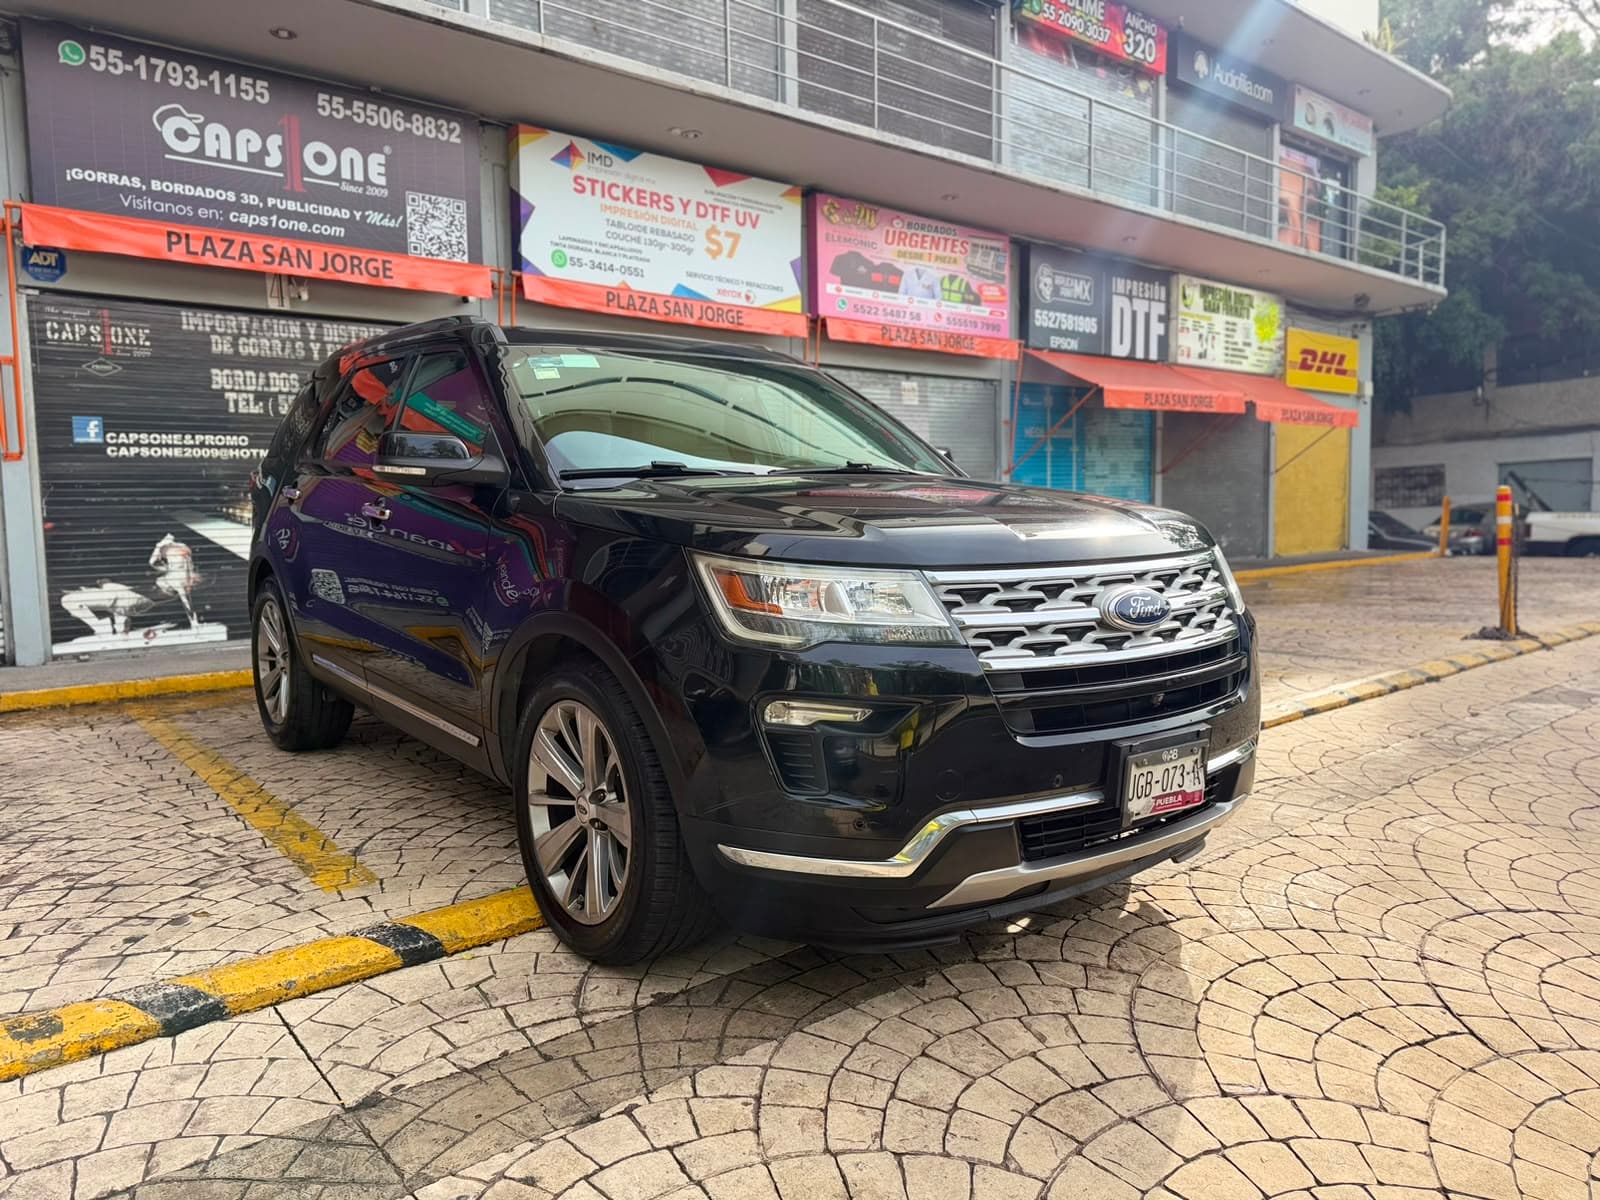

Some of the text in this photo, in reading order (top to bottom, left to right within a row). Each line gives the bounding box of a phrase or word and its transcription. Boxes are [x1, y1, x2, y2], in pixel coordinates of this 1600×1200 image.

[1042, 3, 1111, 43] 55 2090 3037
[1125, 12, 1158, 37] ANCHO
[1123, 28, 1157, 64] 320
[89, 45, 270, 104] 55-1793-1155
[317, 92, 461, 144] 55-5506-8832
[587, 151, 614, 168] IMD
[66, 168, 403, 228] ¡GORRAS, BORDADOS 3D, PUBLICIDAD Y Más!
[340, 181, 389, 198] Since 2009
[572, 174, 673, 211] STICKERS
[677, 196, 692, 216] Y
[695, 201, 731, 223] DTF
[735, 209, 761, 230] UV
[198, 206, 224, 221] en:
[229, 211, 345, 238] caps1one.com
[605, 218, 648, 235] TABLOIDE
[660, 216, 699, 232] DIGITAL
[906, 220, 958, 237] BORDADOS
[166, 230, 394, 279] PLAZA SAN JORGE
[704, 224, 742, 261] $7
[884, 229, 970, 256] URGENTES
[29, 253, 58, 267] ADT
[569, 256, 645, 278] 55-3414-0551
[716, 288, 742, 299] xerox
[605, 290, 744, 326] PLAZA SAN JORGE
[306, 322, 317, 341] Y
[1034, 308, 1098, 334] 5527581905
[1111, 294, 1167, 361] DTF
[210, 334, 234, 354] DE
[238, 337, 306, 360] GORRAS
[309, 342, 321, 361] Y
[880, 325, 976, 350] PLAZA SAN JORGE
[1049, 336, 1079, 351] EPSON
[1299, 348, 1348, 376] DHL
[210, 368, 300, 393] BORDADOS
[224, 392, 264, 414] TEL:
[1143, 391, 1169, 406] PLAZA
[105, 432, 249, 446] CAPSONE&PROMO
[1128, 595, 1165, 620] Ford
[1155, 793, 1183, 806] PUEBLA
